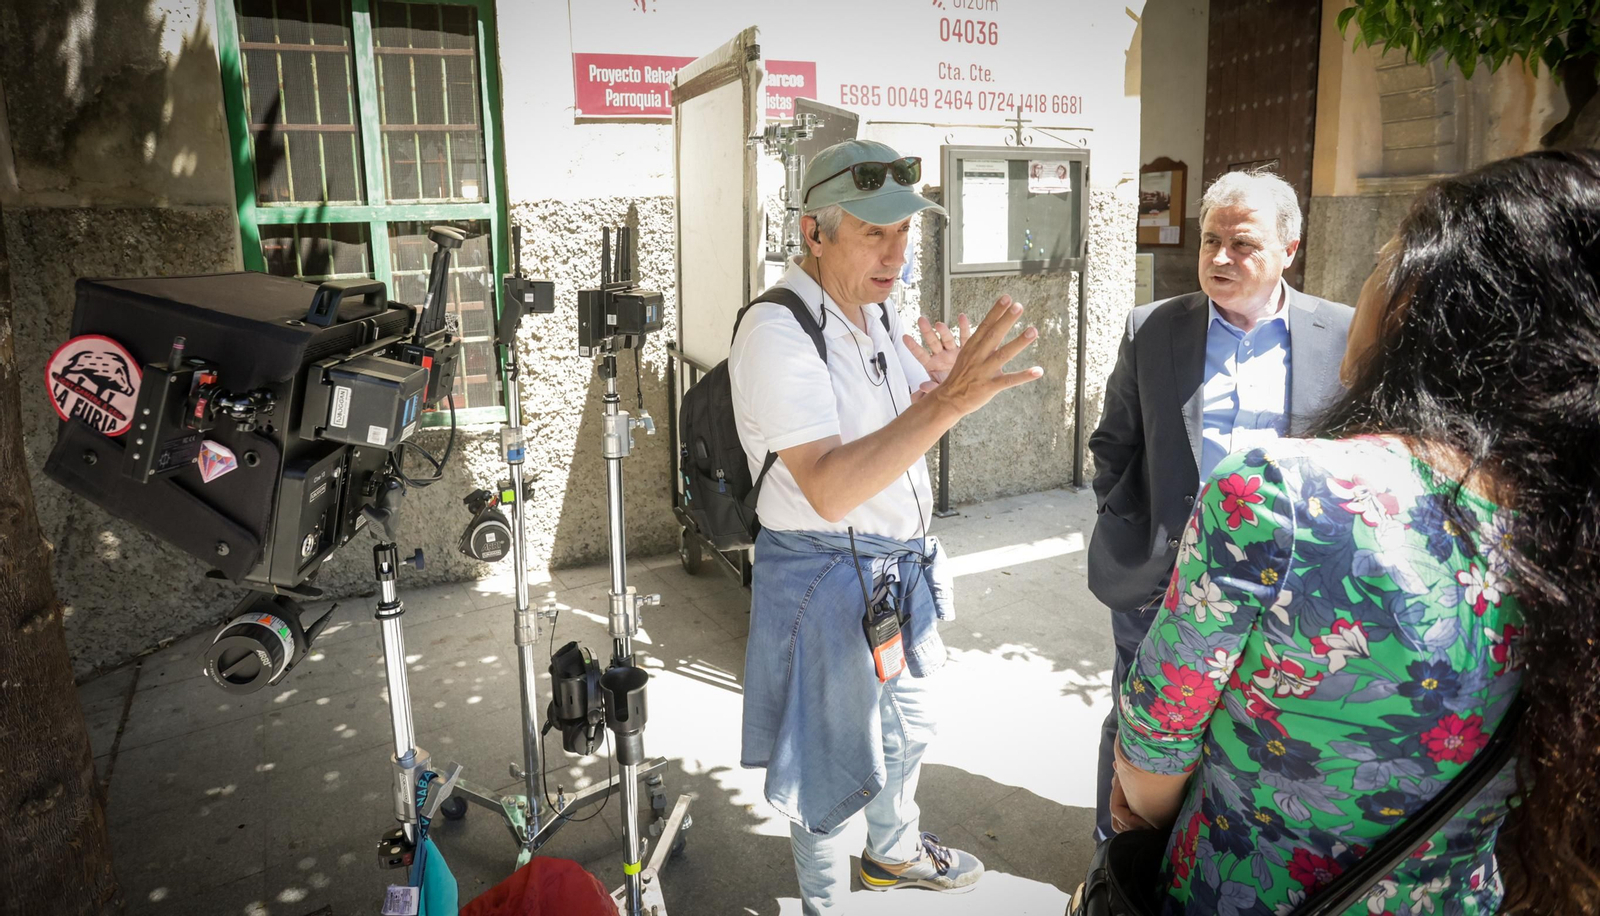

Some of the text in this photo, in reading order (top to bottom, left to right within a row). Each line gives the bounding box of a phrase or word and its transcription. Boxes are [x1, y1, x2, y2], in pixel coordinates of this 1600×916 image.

[940, 17, 998, 45] 04036
[588, 64, 641, 86] Proyecto
[938, 62, 996, 82] Cta. Cte.
[605, 89, 792, 111] Parroquia L istas
[840, 83, 1083, 114] ES85 0049 2464 0724 1418 6681
[53, 383, 69, 410] LA
[481, 542, 502, 553] ARRI
[256, 649, 271, 666] ARRI
